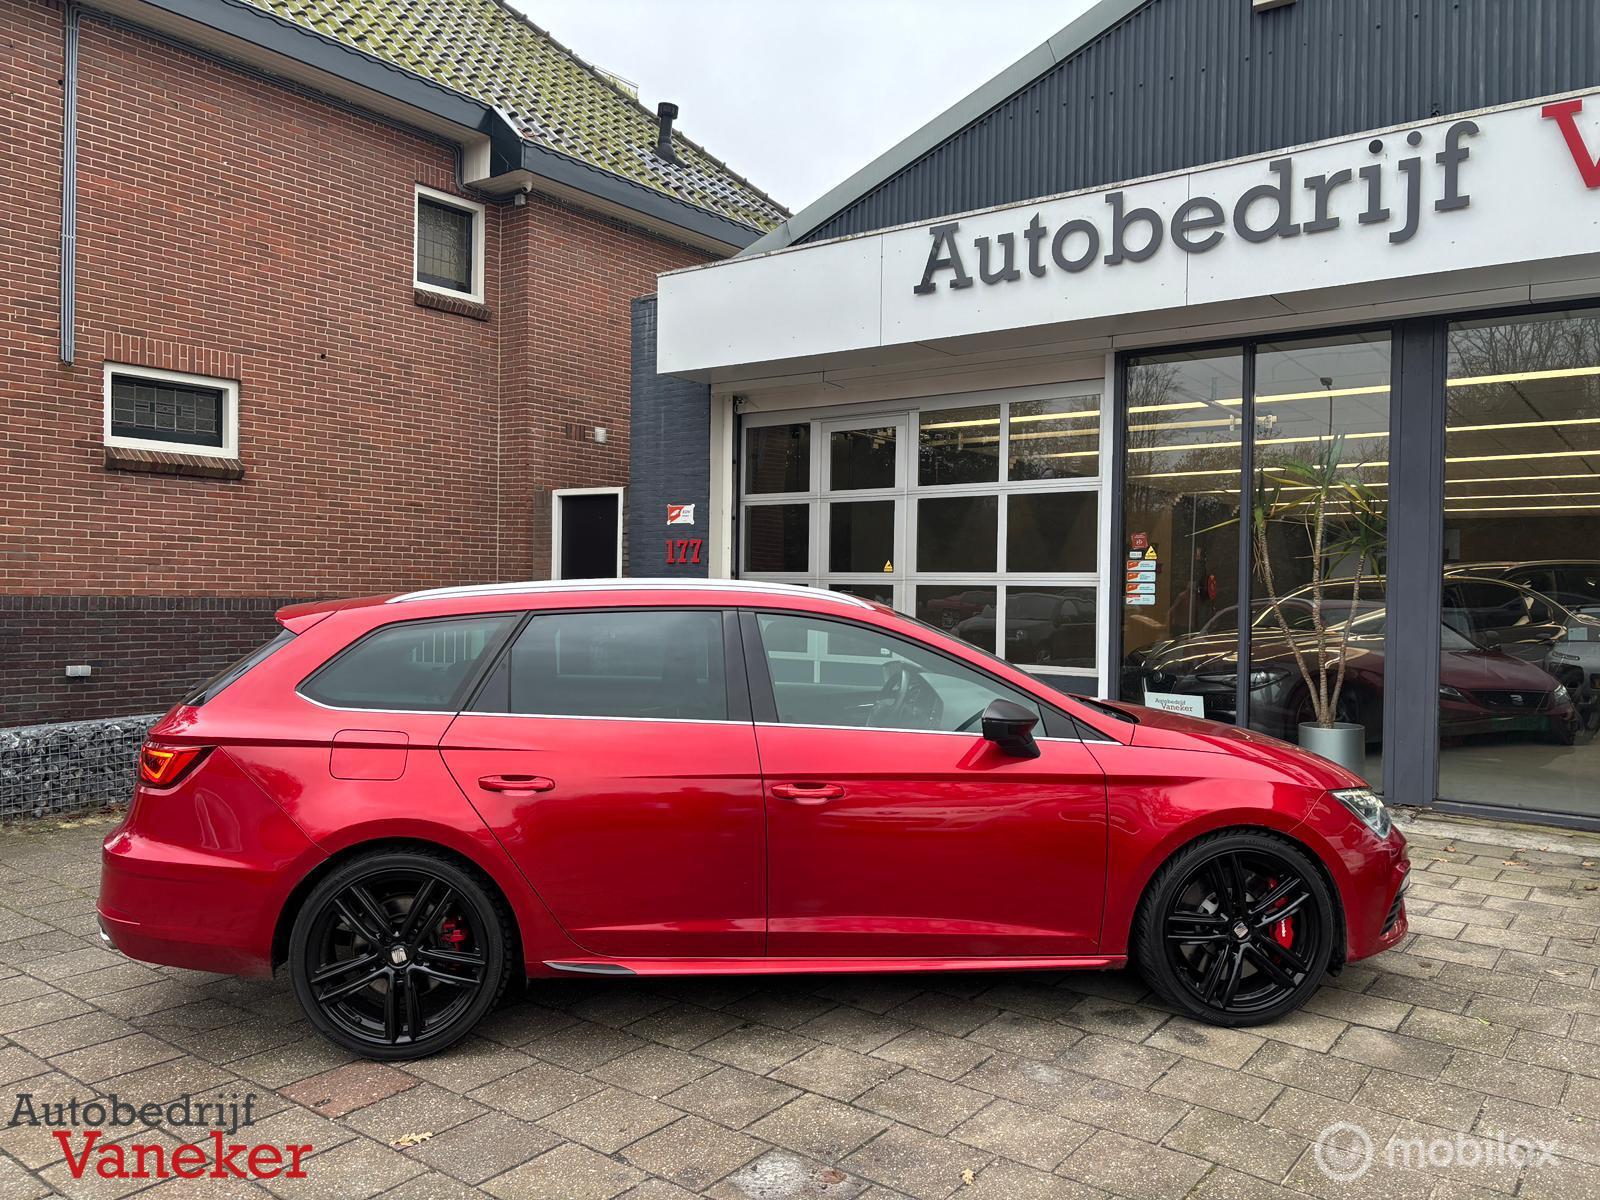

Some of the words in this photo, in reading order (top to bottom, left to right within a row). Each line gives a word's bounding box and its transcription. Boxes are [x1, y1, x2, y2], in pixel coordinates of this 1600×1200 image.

[913, 120, 1480, 295] Autobedrijf
[665, 539, 703, 564] 177
[1161, 702, 1193, 712] Vaneker
